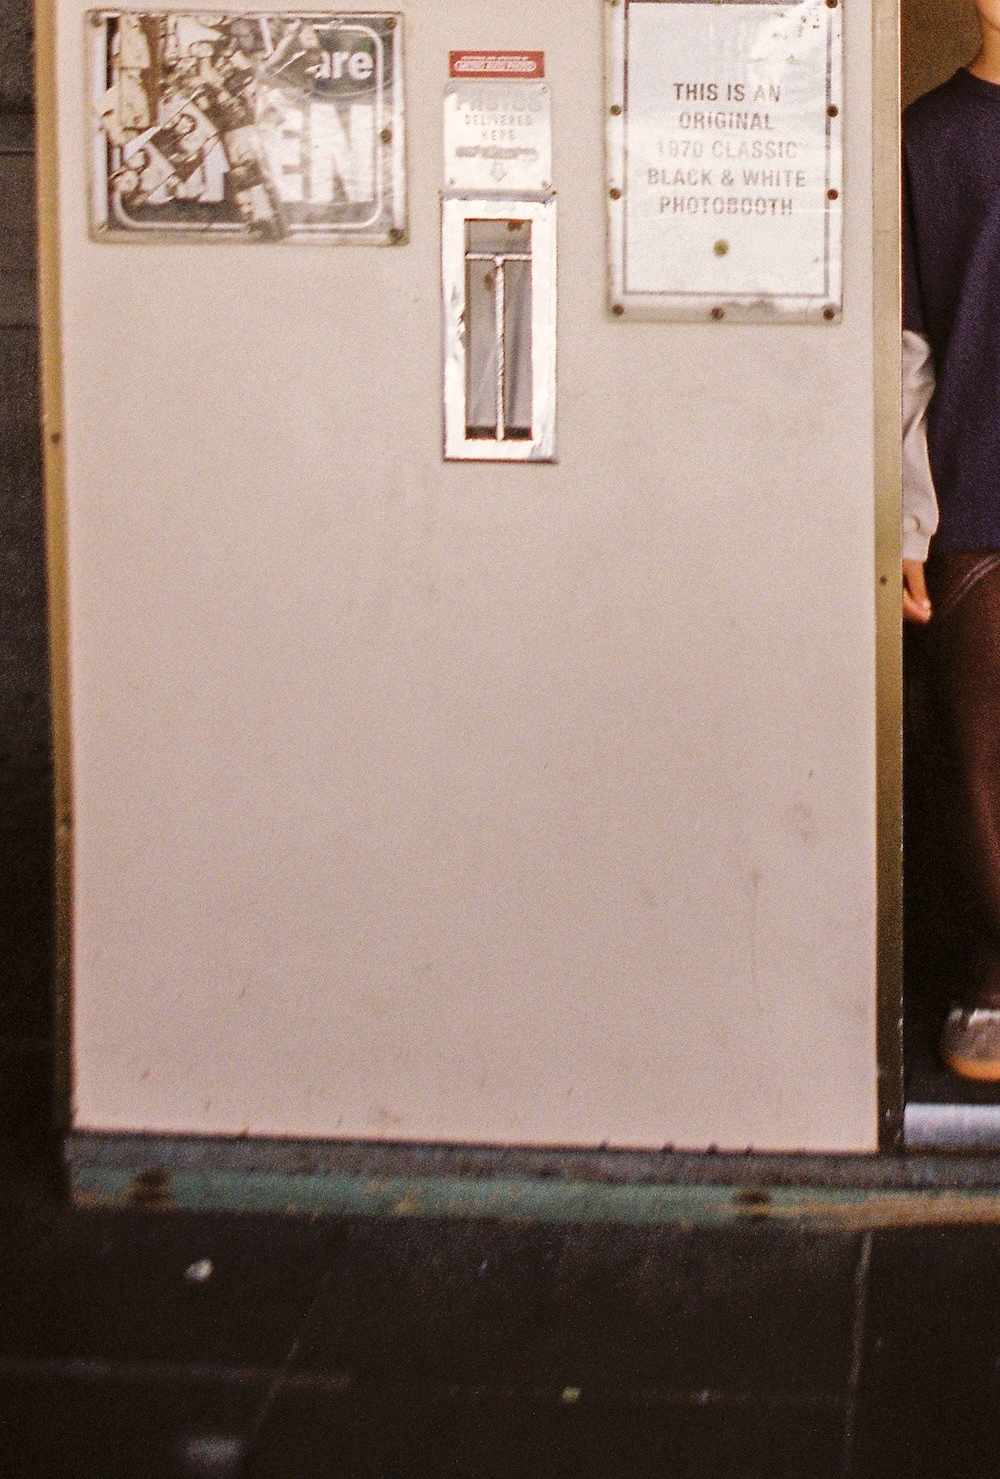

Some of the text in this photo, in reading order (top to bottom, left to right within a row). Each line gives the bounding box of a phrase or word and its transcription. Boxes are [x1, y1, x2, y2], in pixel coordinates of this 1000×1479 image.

[306, 51, 375, 80] are
[673, 83, 782, 102] THIS IS AN
[678, 111, 775, 131] ORIGINAL
[658, 140, 798, 159] 1970 CLASSIC
[647, 168, 807, 188] BLACK & WHITE
[659, 196, 794, 216] PHOTOBOOTH
